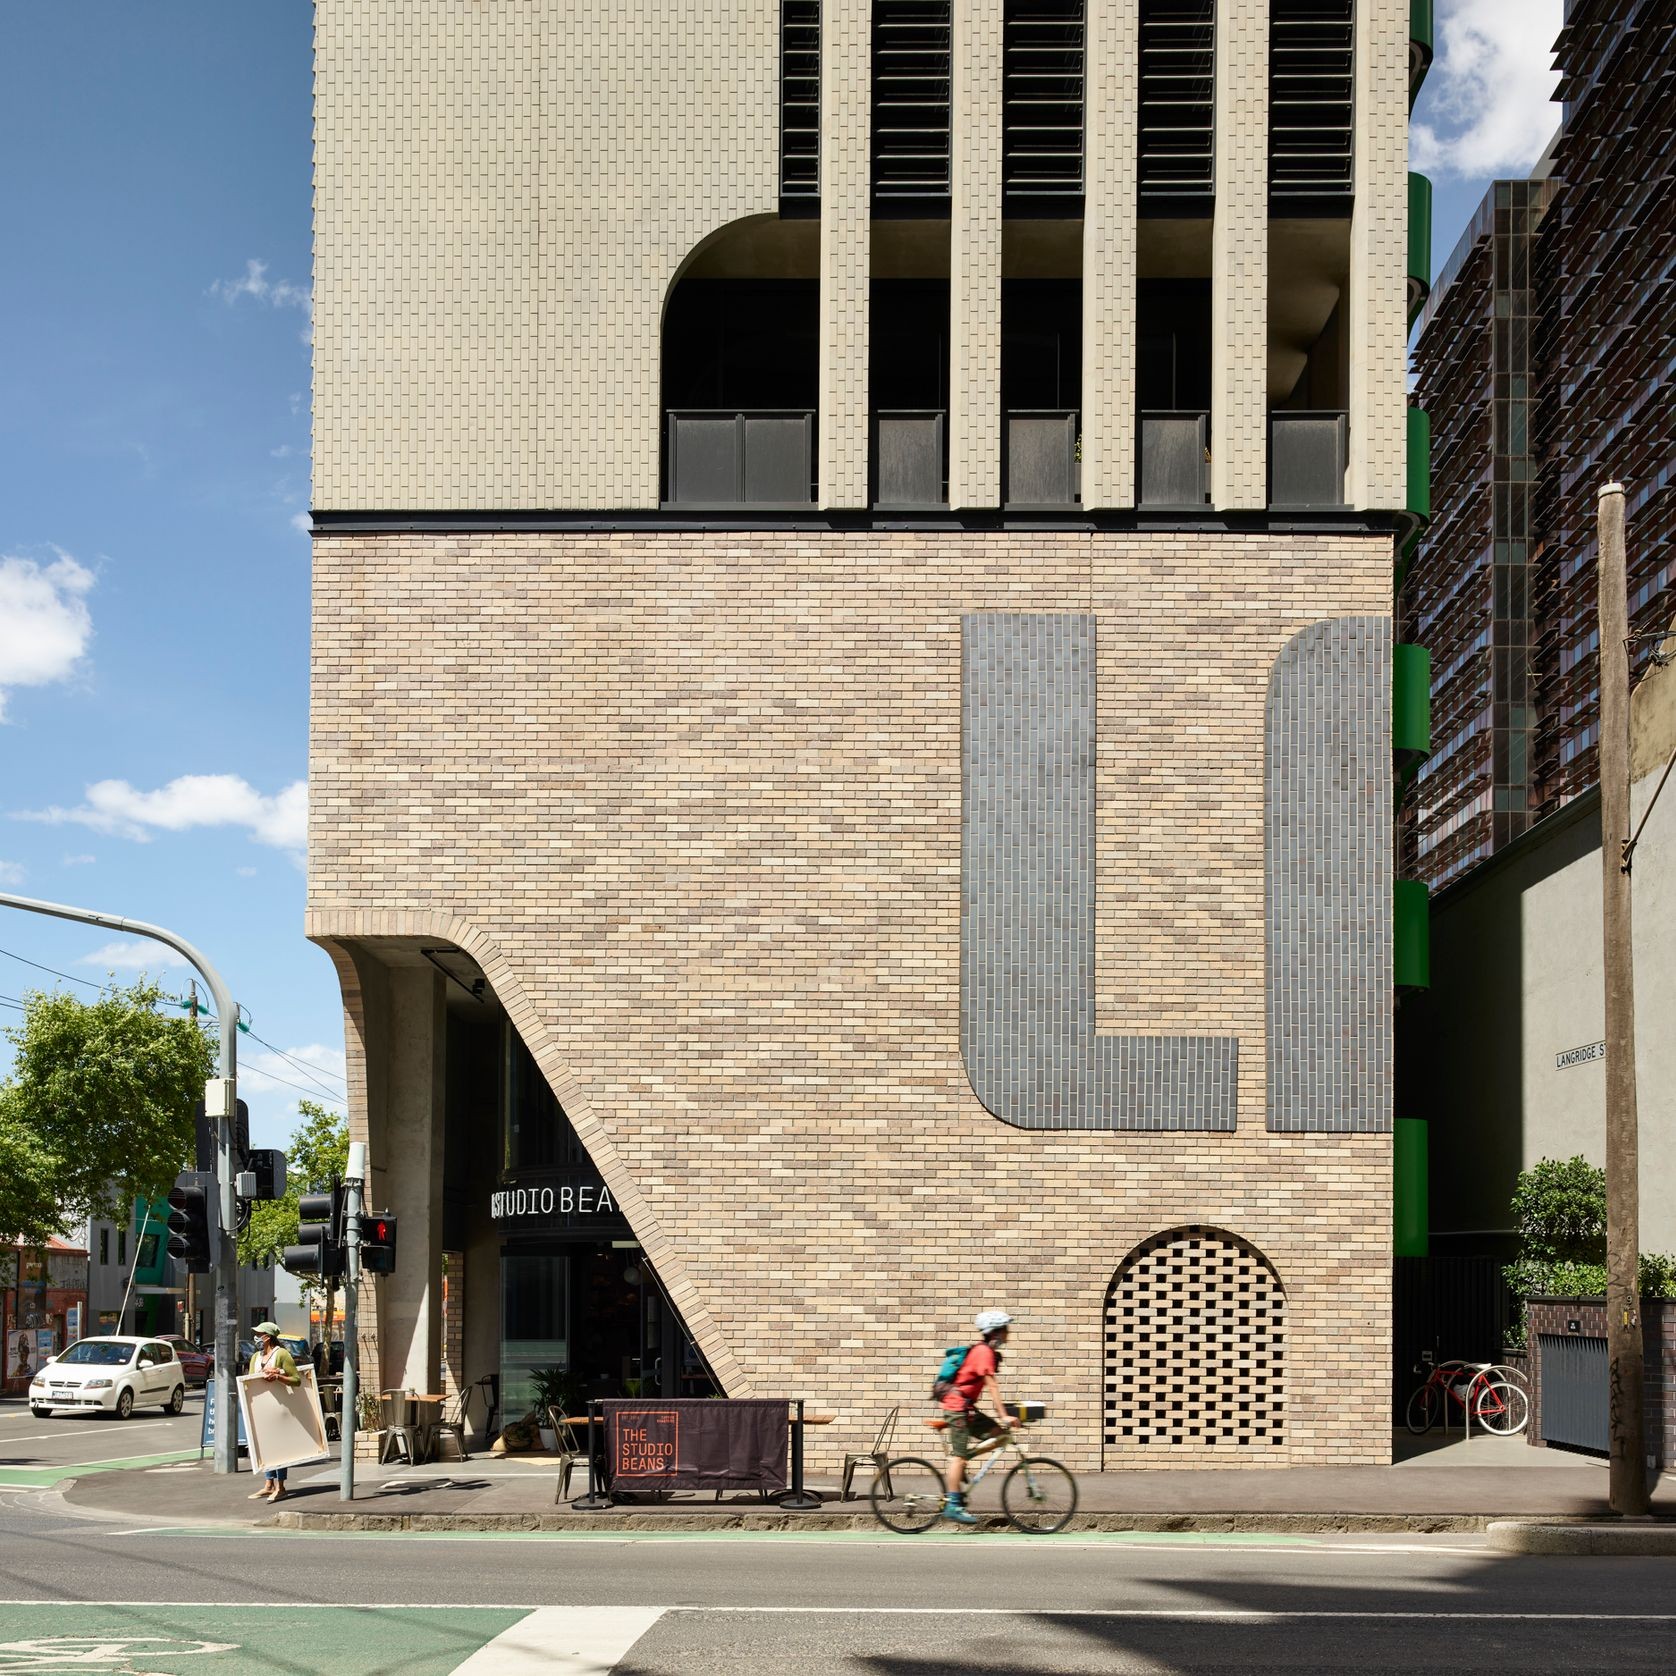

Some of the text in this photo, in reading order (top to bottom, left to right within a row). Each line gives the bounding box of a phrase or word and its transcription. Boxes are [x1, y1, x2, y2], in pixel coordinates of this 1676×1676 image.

[1556, 1043, 1606, 1067] LANGRIDGE S
[494, 1187, 554, 1218] STUDIO
[560, 1186, 623, 1213] BEA
[622, 1428, 647, 1442] THE
[622, 1443, 673, 1456] STUDIO
[622, 1457, 665, 1470] BEANS
